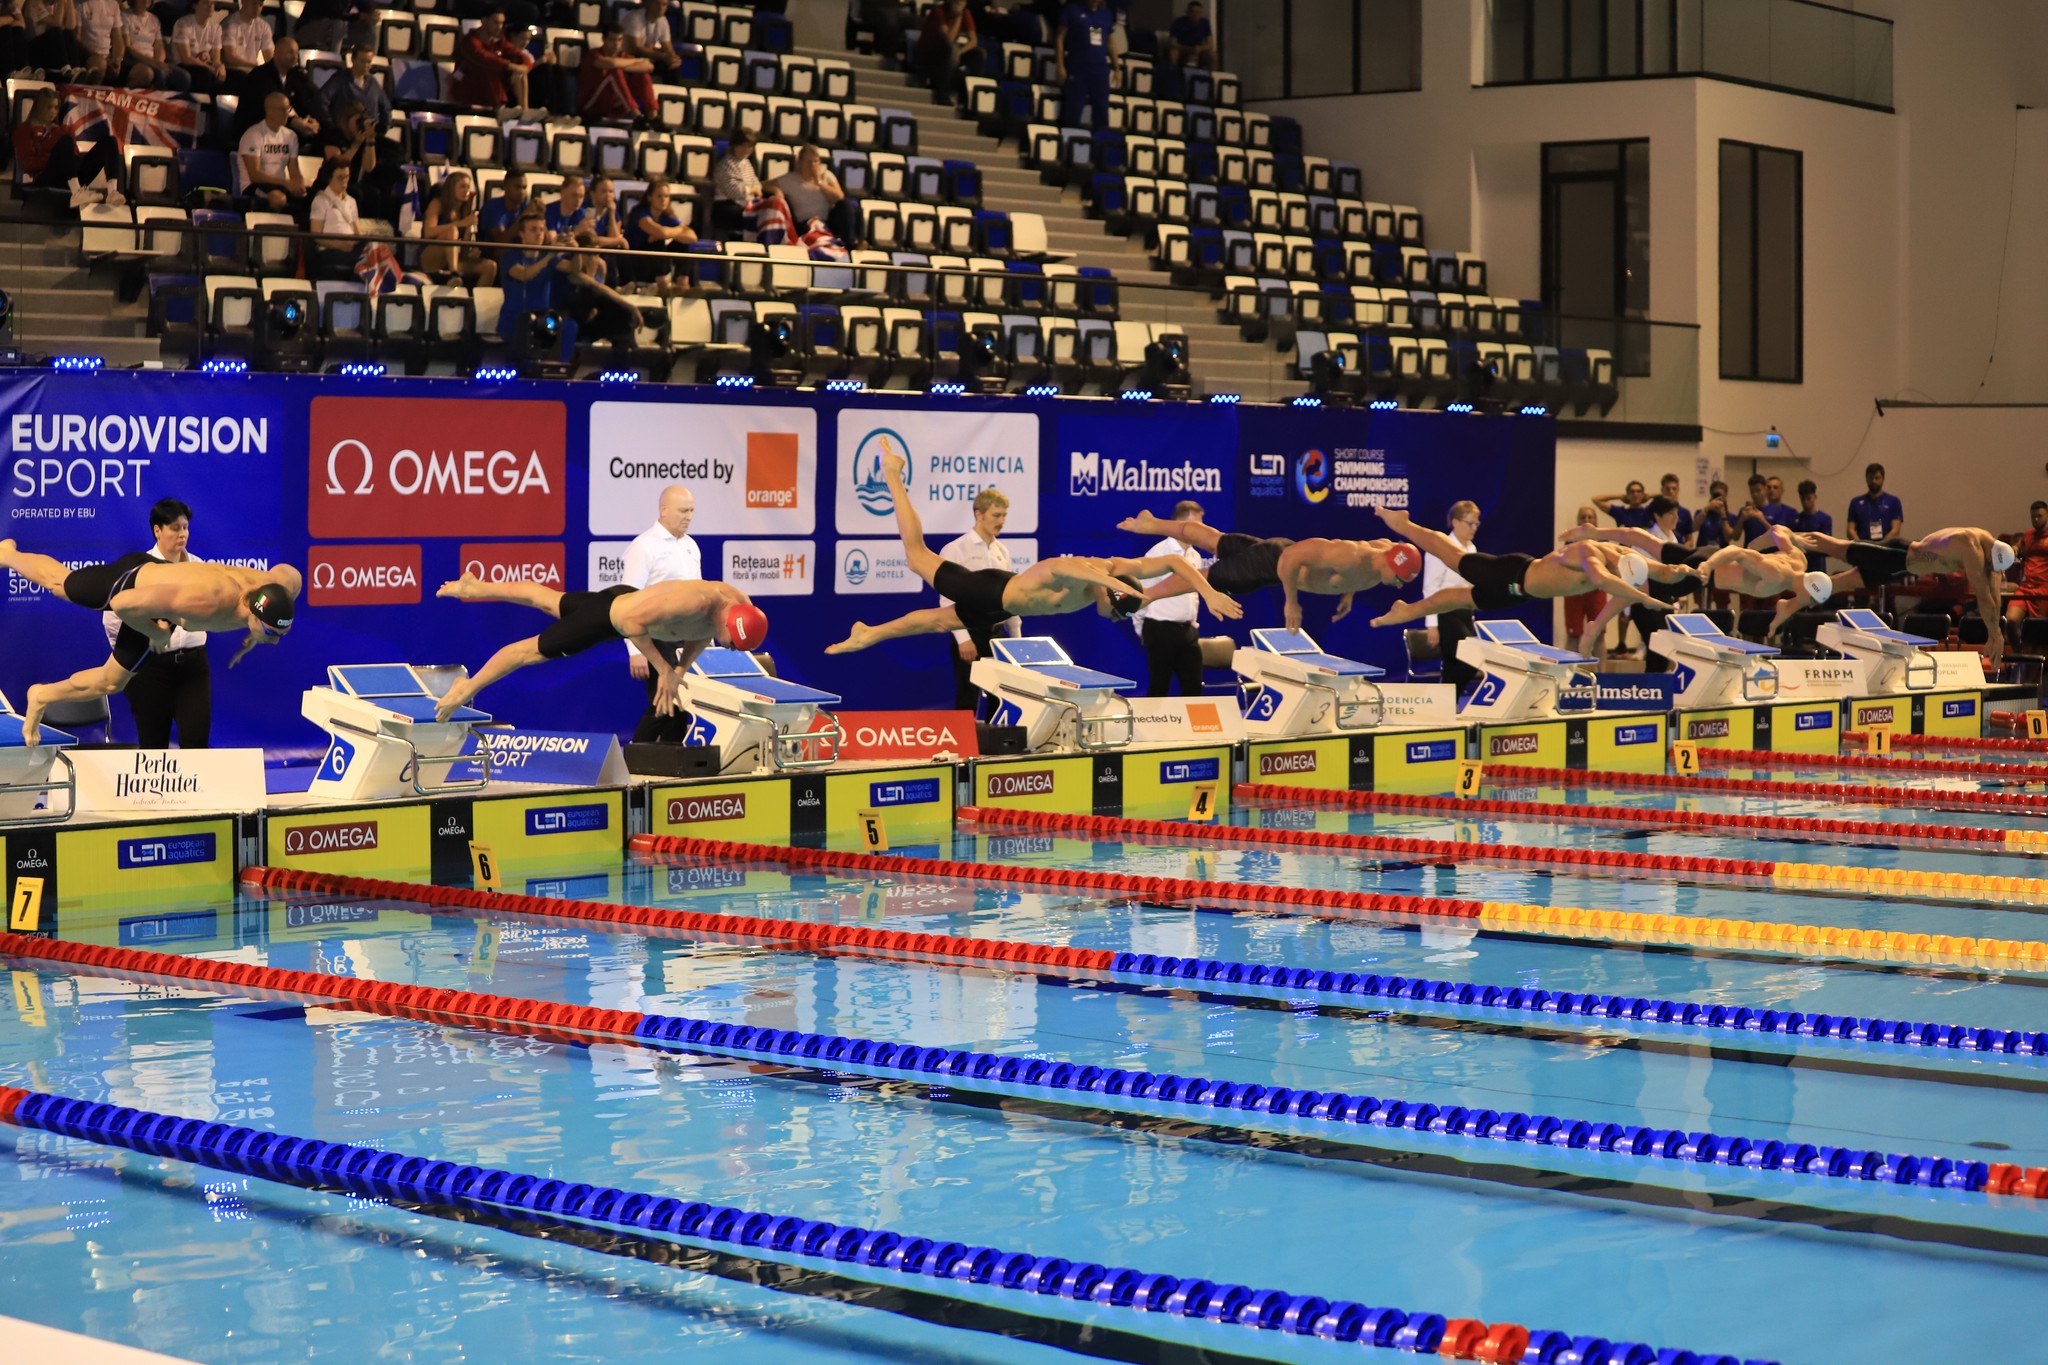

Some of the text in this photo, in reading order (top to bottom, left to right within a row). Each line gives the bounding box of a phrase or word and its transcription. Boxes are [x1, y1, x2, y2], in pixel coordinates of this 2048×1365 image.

[84, 88, 160, 116] TEAM GB
[264, 144, 289, 154] arena
[1334, 449, 1385, 460] SHORT COURSE
[389, 449, 550, 495] OMEGA
[610, 457, 734, 484] Connected by
[930, 456, 1024, 473] PHOENICIA
[1334, 461, 1385, 475] SWIMMING
[12, 458, 150, 497] SPORT
[1101, 459, 1222, 492] Malmsten
[1334, 477, 1409, 492] CHAMPIONSHIPS
[1347, 494, 1409, 508] OTOPENI 2023
[11, 507, 96, 518] OPERATED BY EBU
[490, 563, 560, 584] OMEGA
[759, 571, 780, 580] mobil
[783, 553, 806, 579] #1
[341, 565, 417, 588] OMEGA
[254, 602, 264, 613] ITA
[1677, 671, 1685, 691] 1
[1805, 669, 1854, 679] FRNPM
[1481, 681, 1496, 702] 2
[1529, 689, 1549, 709] 2
[1260, 694, 1273, 717] 3
[1311, 702, 1331, 724] 3
[997, 710, 1009, 726] 4
[1170, 714, 1182, 724] by
[1866, 709, 1893, 723] OMEGA
[1698, 721, 1729, 737] OMEGA
[2032, 718, 2041, 735] 0
[693, 727, 706, 746] 5
[856, 726, 958, 747] OMEGA
[1502, 737, 1537, 753] OMEGA
[1876, 732, 1882, 750] 1
[134, 752, 180, 775] Perla
[332, 746, 345, 775] 6
[1274, 754, 1315, 772] OMEGA
[1681, 750, 1692, 769] 2
[116, 773, 200, 800] Harghitei
[1004, 774, 1053, 793] OMEGA
[1098, 775, 1118, 783] OMEGA
[1462, 769, 1474, 789] 3
[688, 798, 744, 819] OMEGA
[797, 798, 821, 807] OMEGA
[1195, 792, 1208, 814] 4
[309, 826, 376, 849] OMEGA
[438, 826, 465, 836] OMEGA
[866, 820, 879, 845] 5
[168, 840, 205, 850] european
[16, 859, 48, 869] OMEGA
[168, 849, 205, 861] aquatics
[478, 853, 491, 881] 6
[19, 891, 32, 922] 7
